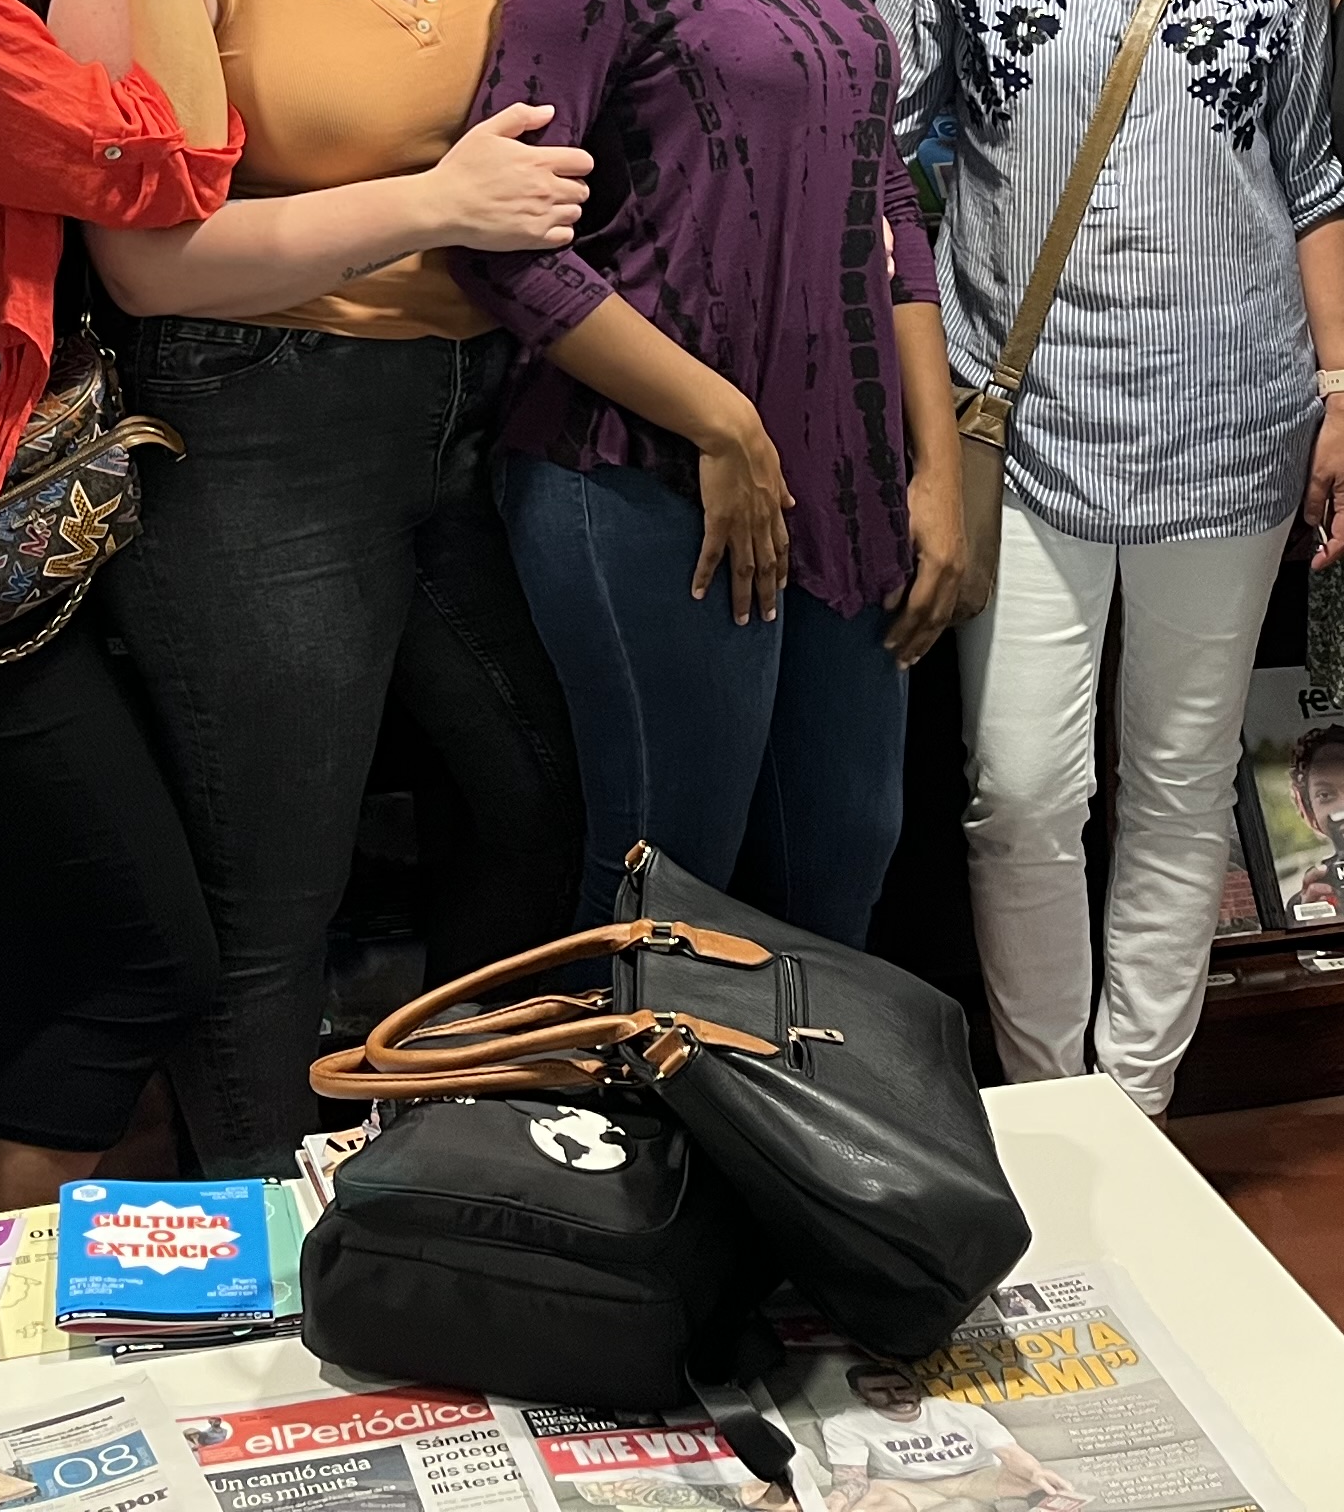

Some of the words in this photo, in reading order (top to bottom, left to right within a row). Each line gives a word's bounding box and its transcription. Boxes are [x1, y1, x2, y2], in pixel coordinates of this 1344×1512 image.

[92, 1213, 231, 1230] CULTURA
[86, 1242, 239, 1259] EXTINCIÓ
[147, 1230, 177, 1244] O
[978, 1326, 1080, 1366] VOY
[1087, 1320, 1131, 1351] A
[245, 1401, 490, 1457] elPeriódico
[532, 1415, 588, 1428] MESSI
[633, 1427, 723, 1461] VOY
[52, 1443, 140, 1489] 08
[209, 1474, 244, 1495] Un
[246, 1462, 317, 1490] camió
[319, 1456, 373, 1477] cada
[427, 1464, 459, 1481] els
[464, 1457, 518, 1474] seus
[232, 1487, 274, 1510] dos
[276, 1475, 359, 1501] minuts
[431, 1474, 500, 1496] llistes
